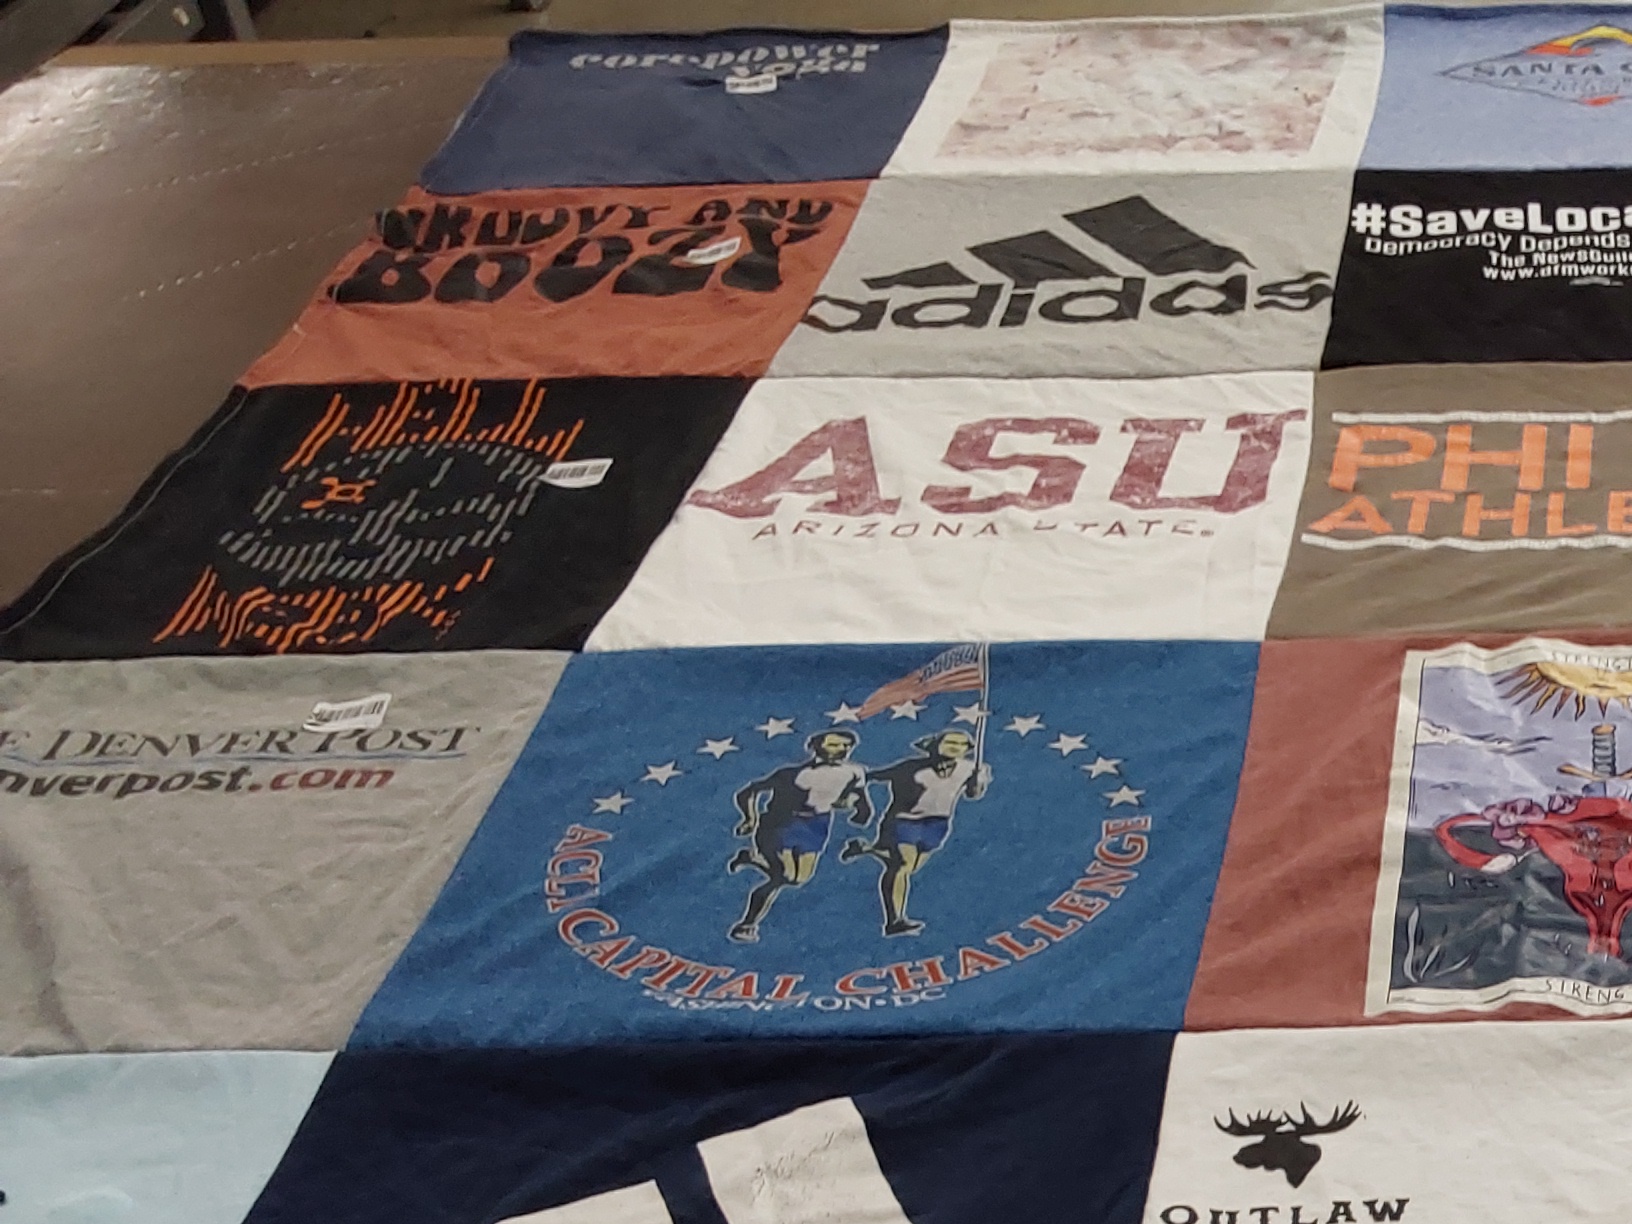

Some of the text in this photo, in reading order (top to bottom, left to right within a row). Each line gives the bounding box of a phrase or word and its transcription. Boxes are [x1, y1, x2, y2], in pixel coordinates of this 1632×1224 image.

[1472, 62, 1605, 78] SANTA
[1364, 231, 1513, 255] Democracy
[1519, 230, 1632, 254] Depends
[1489, 250, 1526, 269] The
[799, 271, 1333, 334] adidas
[685, 408, 1308, 519] ASU
[1328, 423, 1595, 493] PHI
[752, 520, 1000, 541] ARIZONA
[42, 728, 298, 761] DENVER
[314, 725, 481, 754] POST
[558, 907, 812, 1002] CAPITAL
[835, 814, 1152, 995] CHALLENGE
